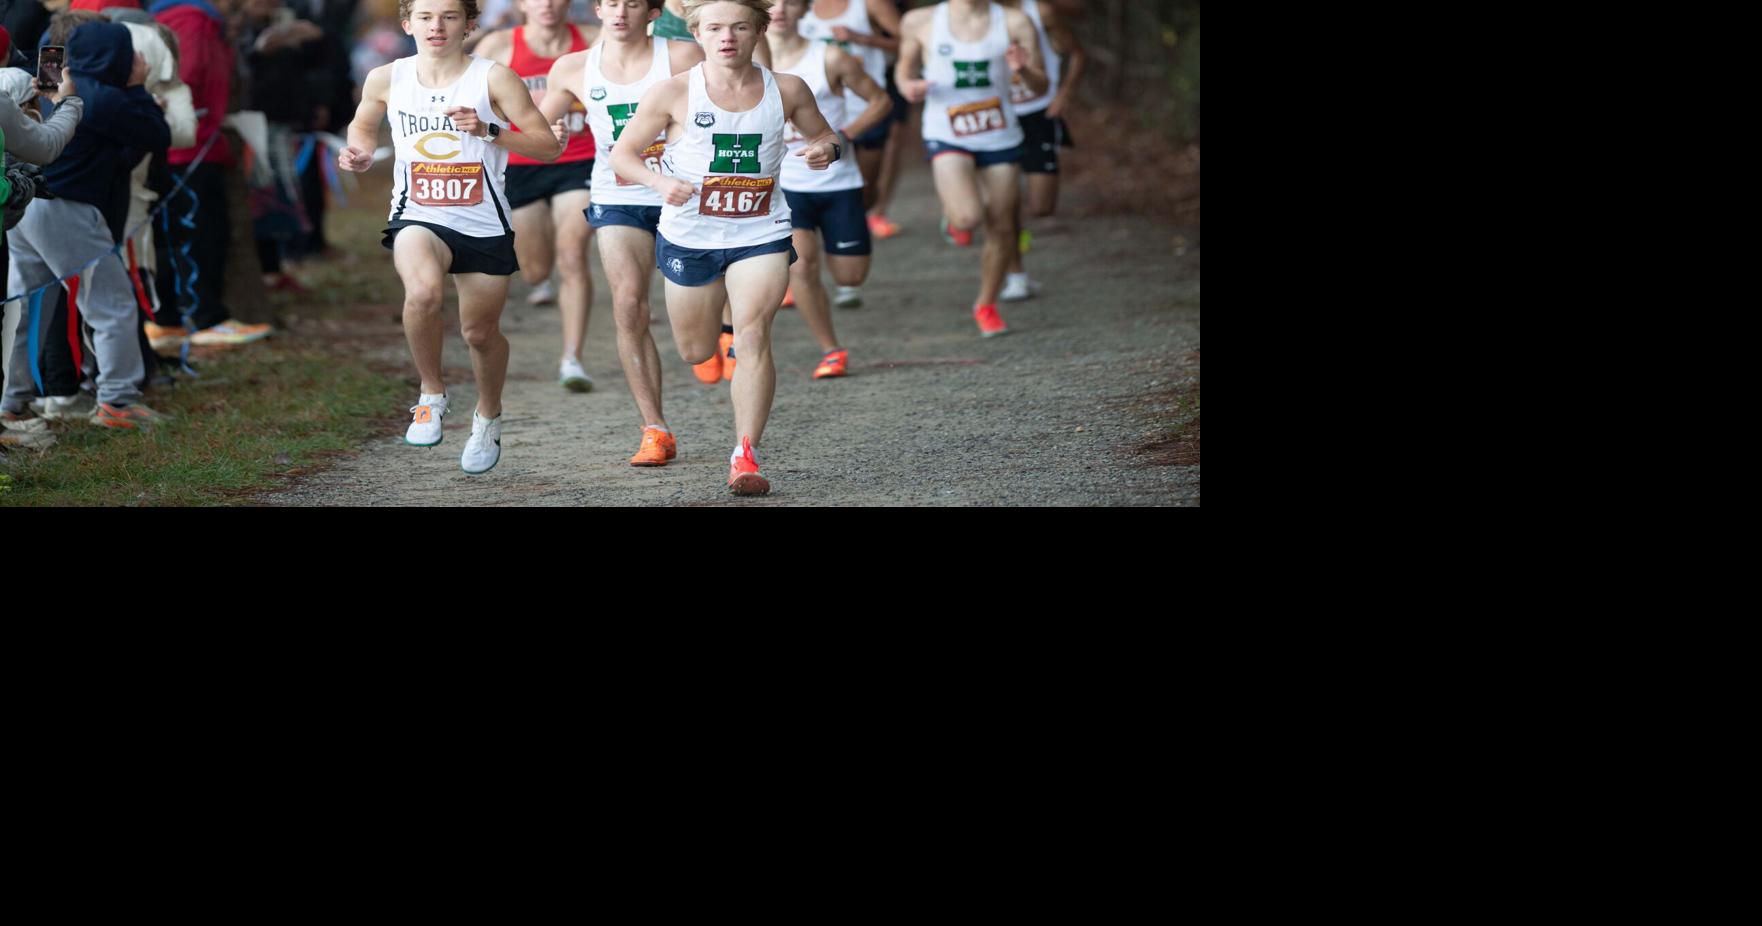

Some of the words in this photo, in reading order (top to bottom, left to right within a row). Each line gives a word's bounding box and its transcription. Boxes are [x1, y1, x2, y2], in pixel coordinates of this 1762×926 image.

[414, 132, 461, 160] C
[709, 133, 762, 173] H
[718, 149, 754, 158] HOYAS
[416, 178, 477, 200] 3807
[705, 190, 767, 212] 4167
